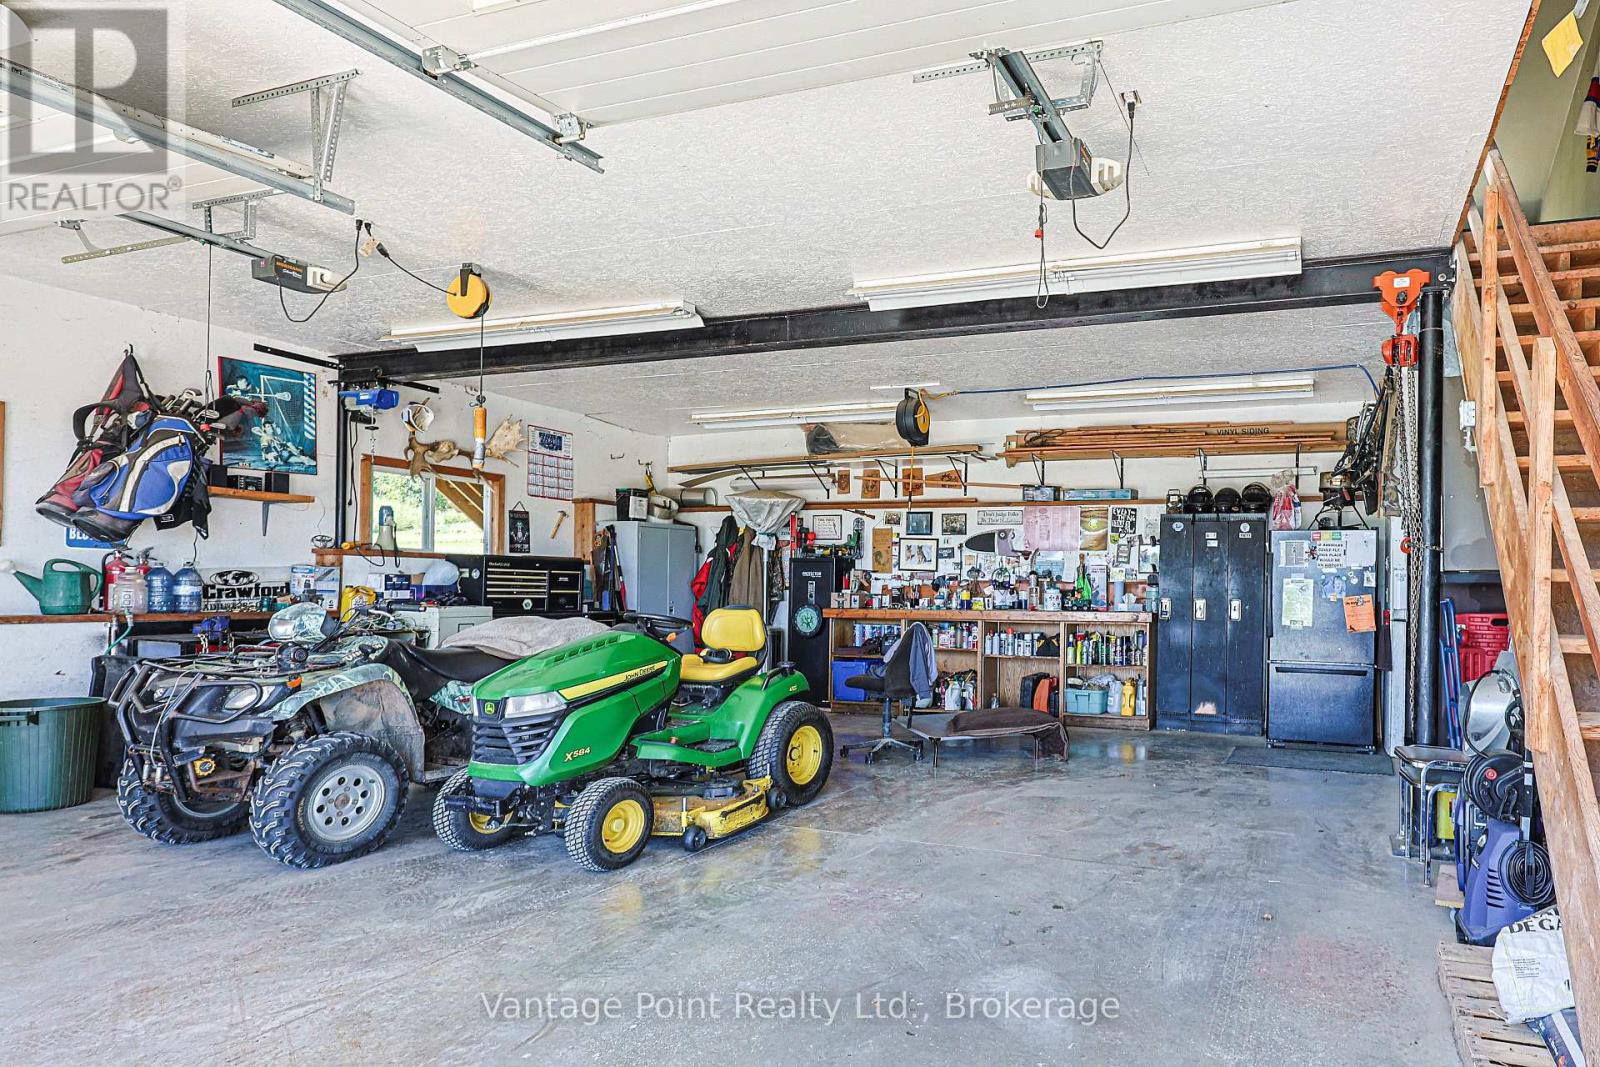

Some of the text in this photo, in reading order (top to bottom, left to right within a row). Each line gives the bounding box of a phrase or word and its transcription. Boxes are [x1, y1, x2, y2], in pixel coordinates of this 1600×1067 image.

[1217, 427, 1270, 436] VINYL SIDING
[202, 582, 291, 600] Crawford
[624, 665, 656, 681] JOHN DEERE
[564, 747, 591, 762] X584
